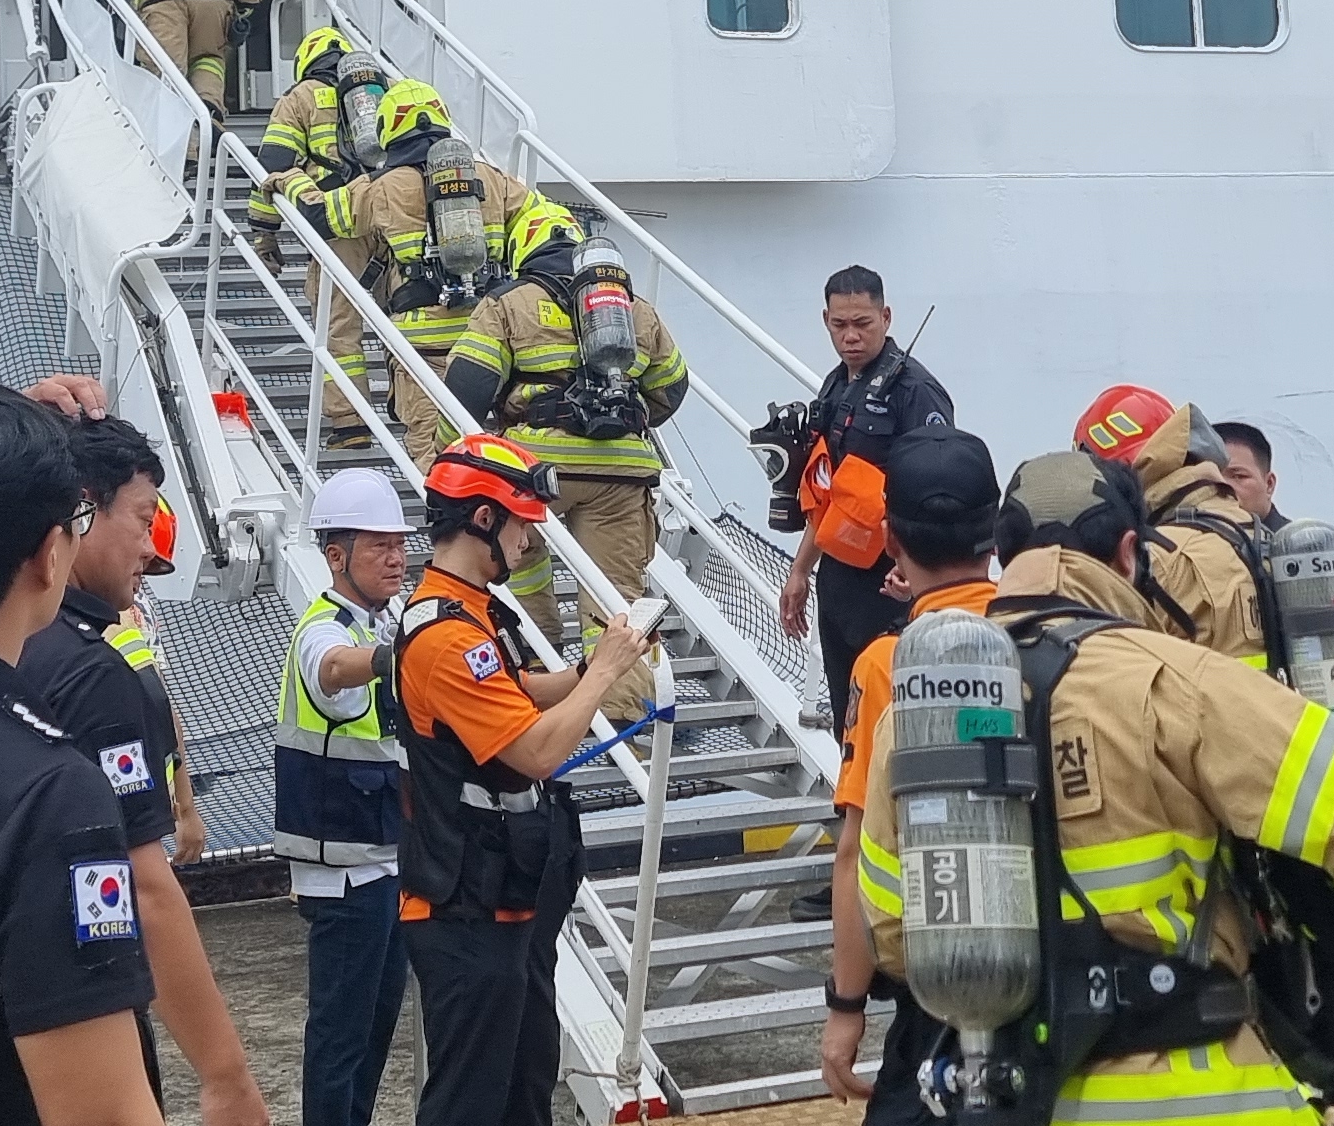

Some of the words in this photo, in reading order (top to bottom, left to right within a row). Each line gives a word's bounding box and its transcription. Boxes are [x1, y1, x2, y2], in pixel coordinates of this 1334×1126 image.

[1055, 736, 1091, 799] 찰
[114, 781, 149, 797] KOREA
[932, 850, 960, 924] 공기
[89, 921, 133, 938] KOREA
